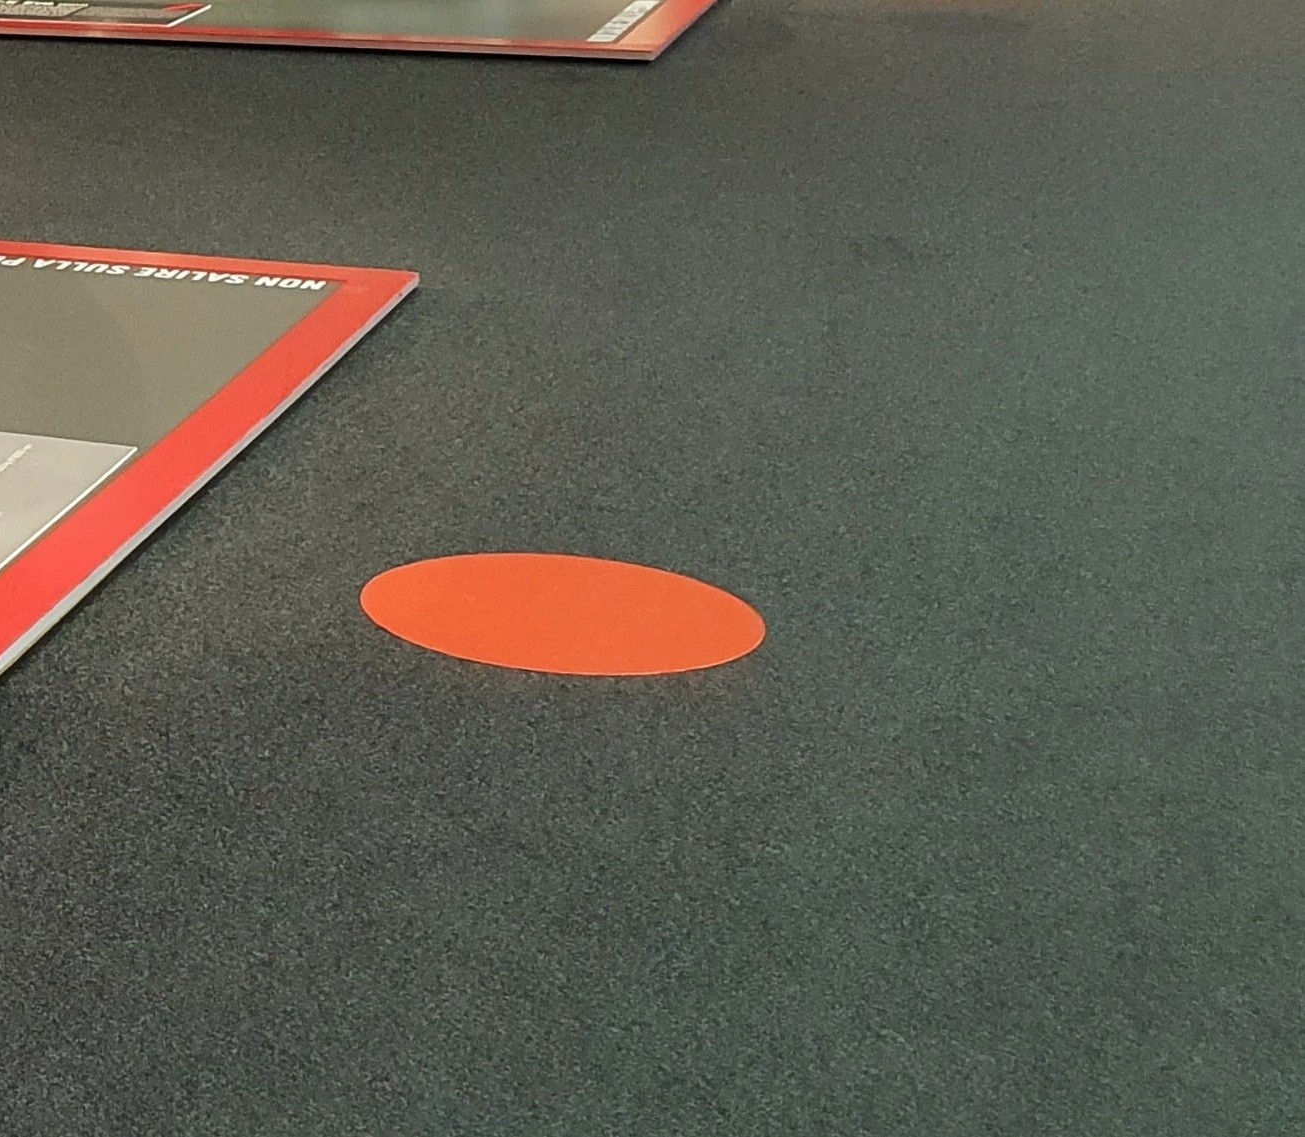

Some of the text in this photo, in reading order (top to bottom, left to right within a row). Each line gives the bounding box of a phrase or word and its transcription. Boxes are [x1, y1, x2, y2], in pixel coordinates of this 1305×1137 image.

[33, 258, 131, 275] SULLA
[133, 266, 250, 284] SALIRE
[254, 276, 328, 291] NON
